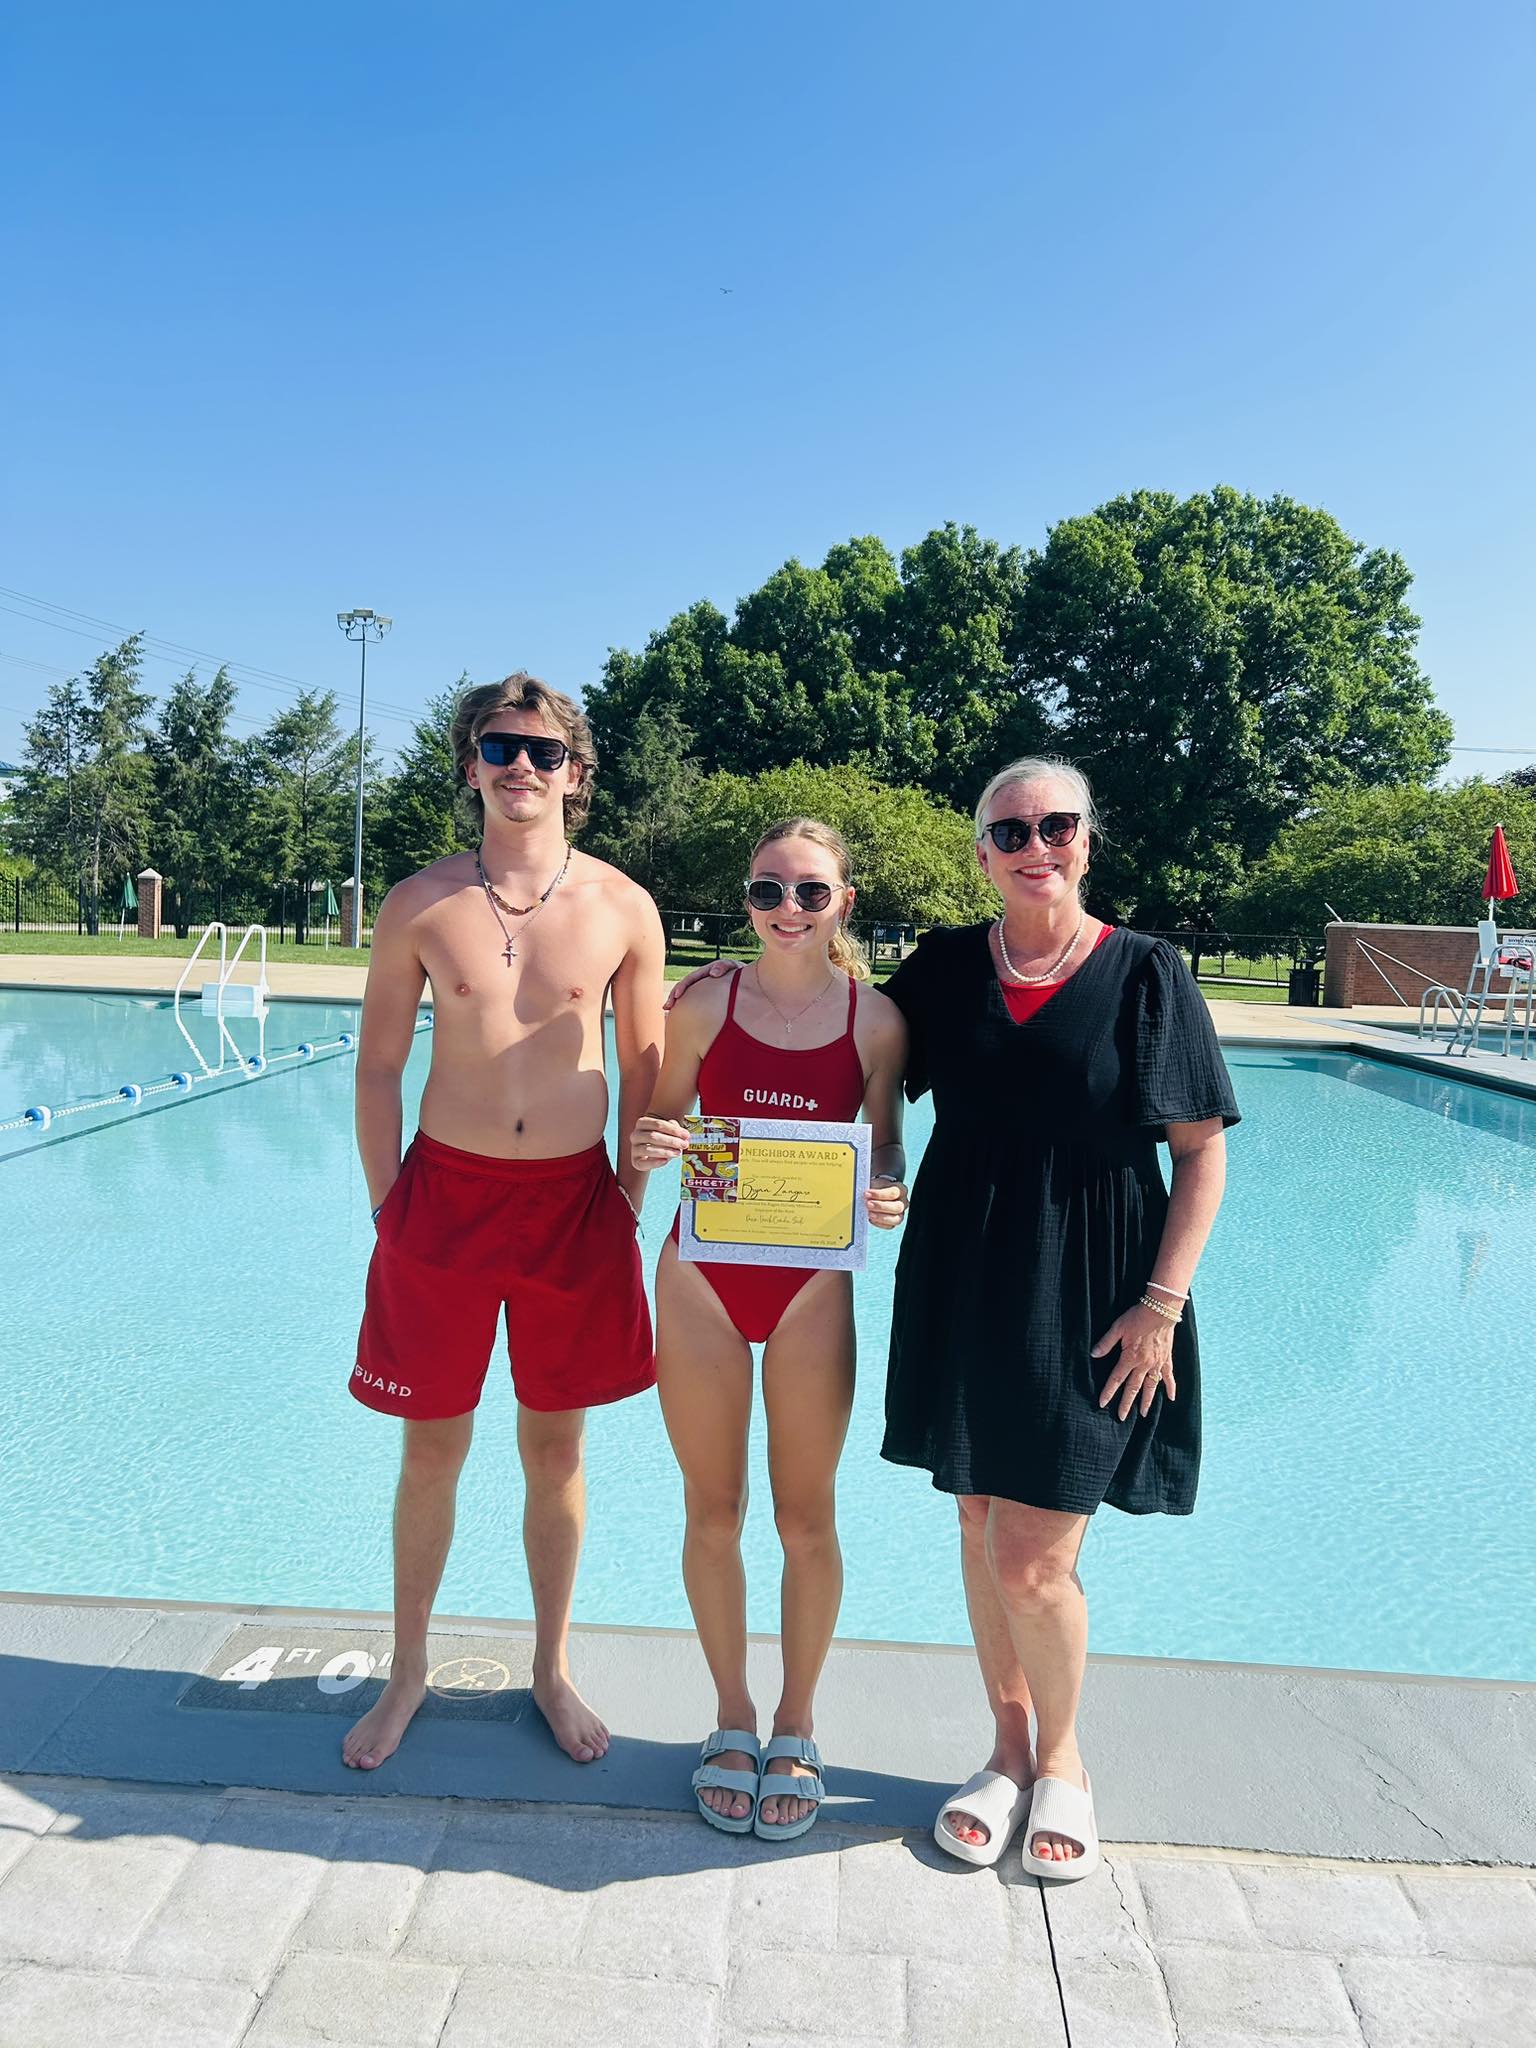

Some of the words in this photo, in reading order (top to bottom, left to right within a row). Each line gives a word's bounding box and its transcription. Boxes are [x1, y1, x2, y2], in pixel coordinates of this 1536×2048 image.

[745, 1148, 796, 1159] NEIGHBOR
[798, 1150, 838, 1160] AWARD
[687, 1179, 731, 1187] SHEETZ
[355, 1364, 412, 1397] GUARD
[218, 1646, 285, 1690] 4
[284, 1647, 322, 1664] FT
[378, 1652, 394, 1667] I
